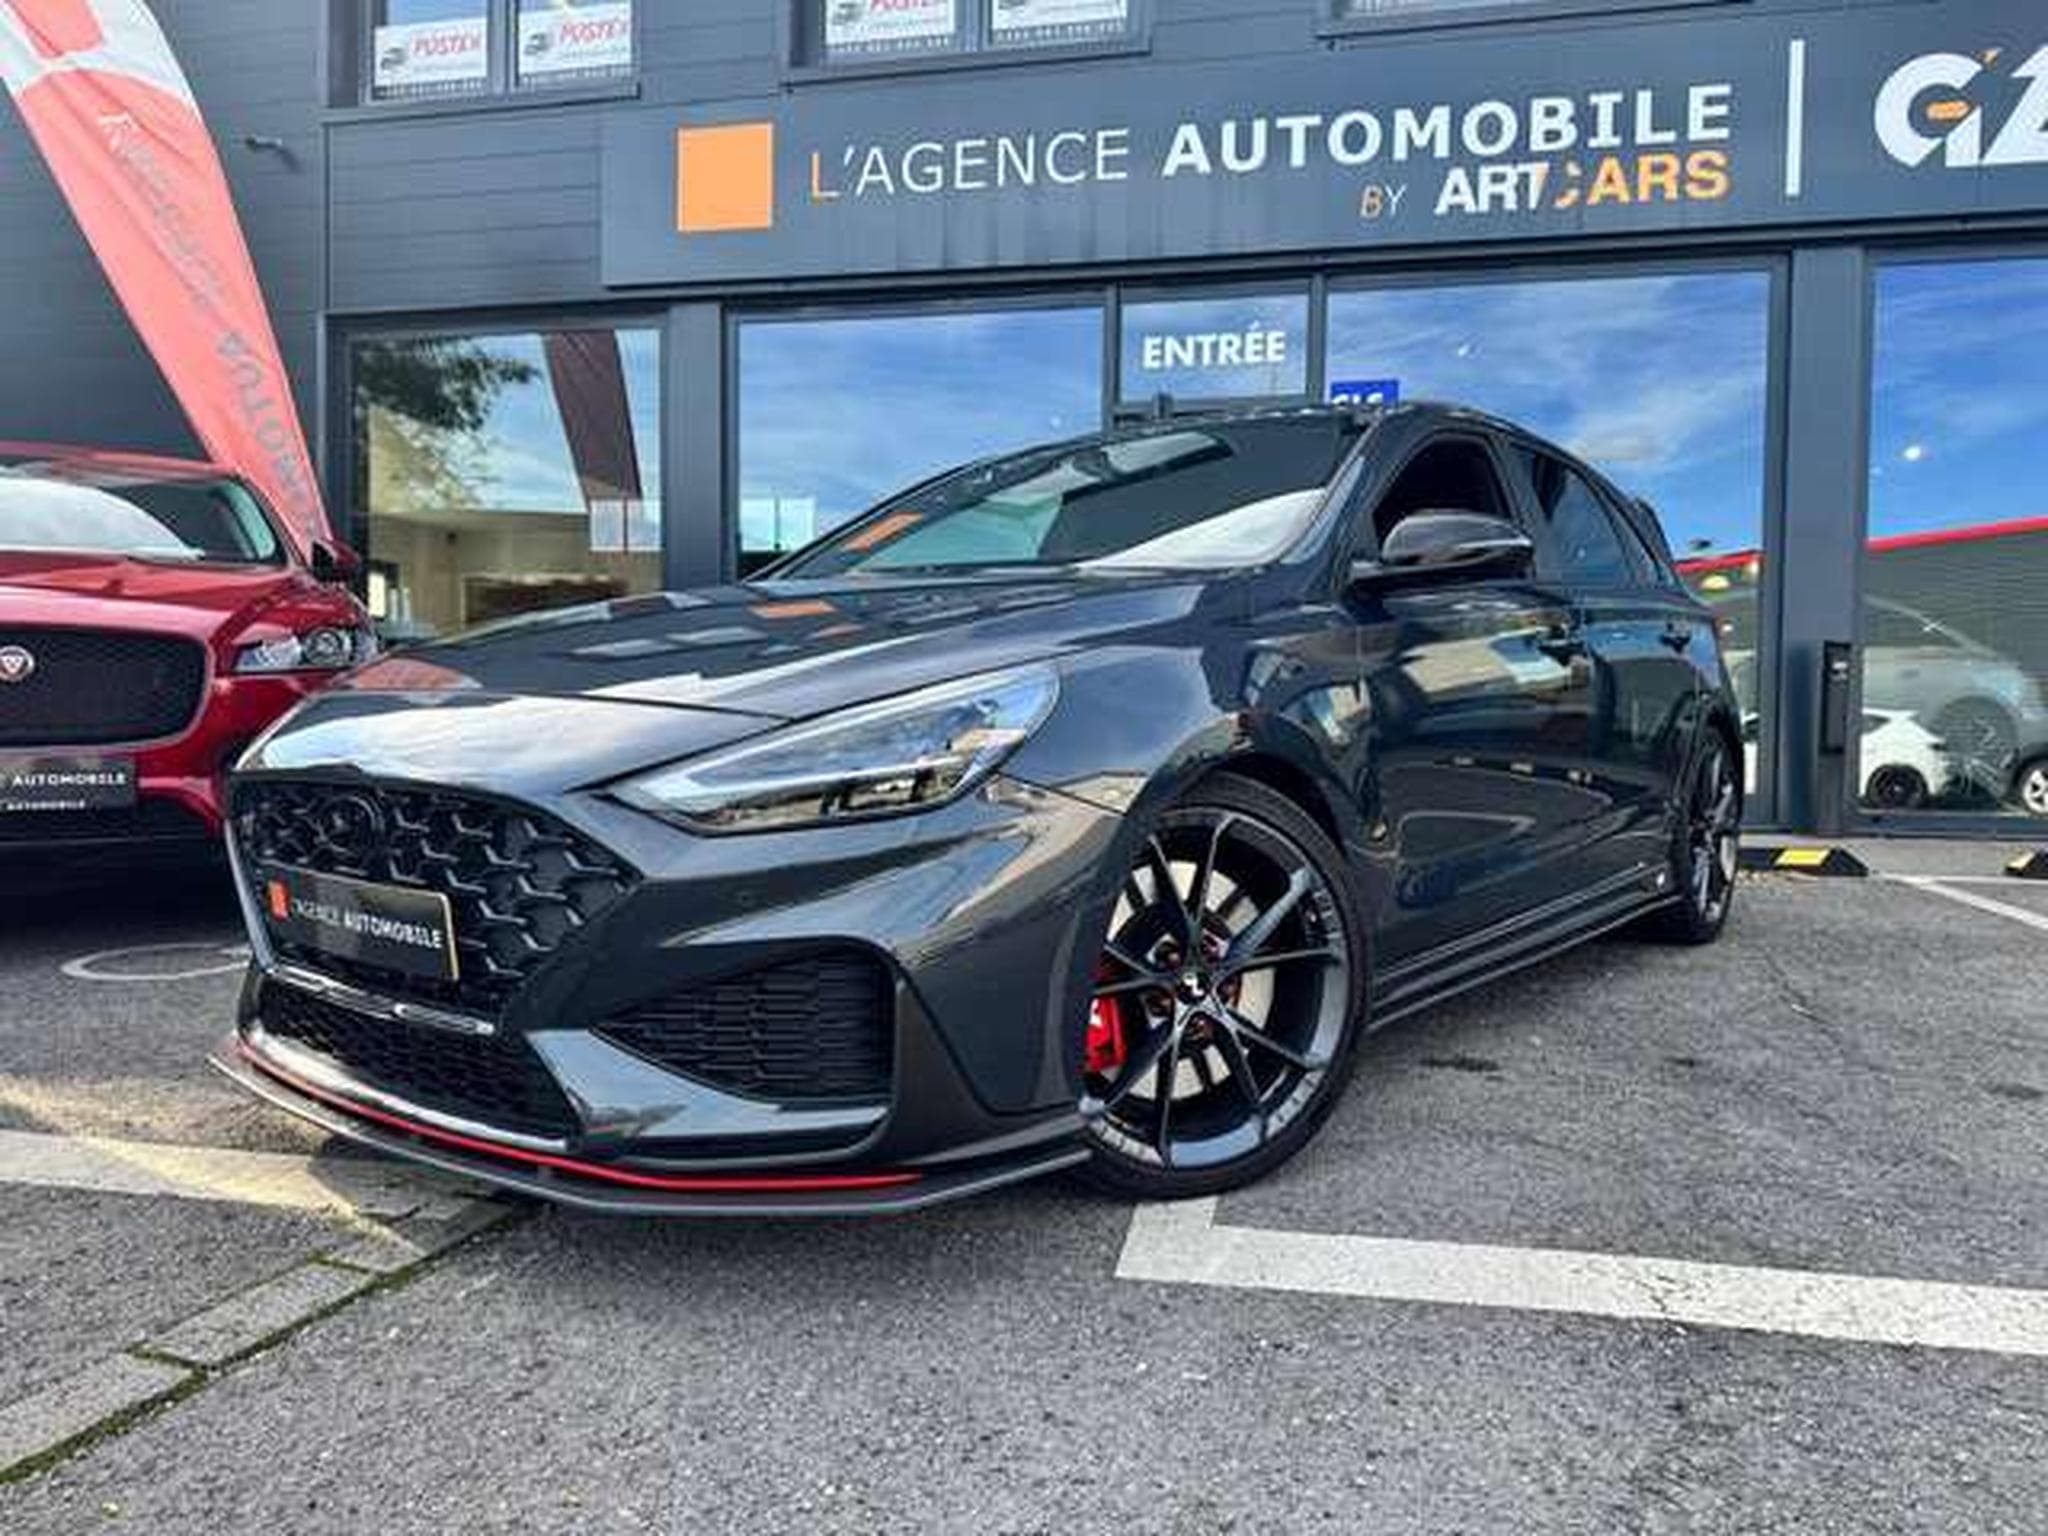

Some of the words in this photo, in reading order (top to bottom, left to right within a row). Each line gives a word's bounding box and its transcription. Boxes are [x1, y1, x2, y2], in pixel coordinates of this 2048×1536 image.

[811, 128, 1130, 198] L'AGENCE
[1162, 83, 1732, 177] AUTOMOBILE
[1360, 184, 1407, 218] BY
[1142, 321, 1287, 371] ENTRÉE
[12, 773, 126, 787] AUTOMOBILE
[343, 908, 443, 949] AUTOMOBILE
